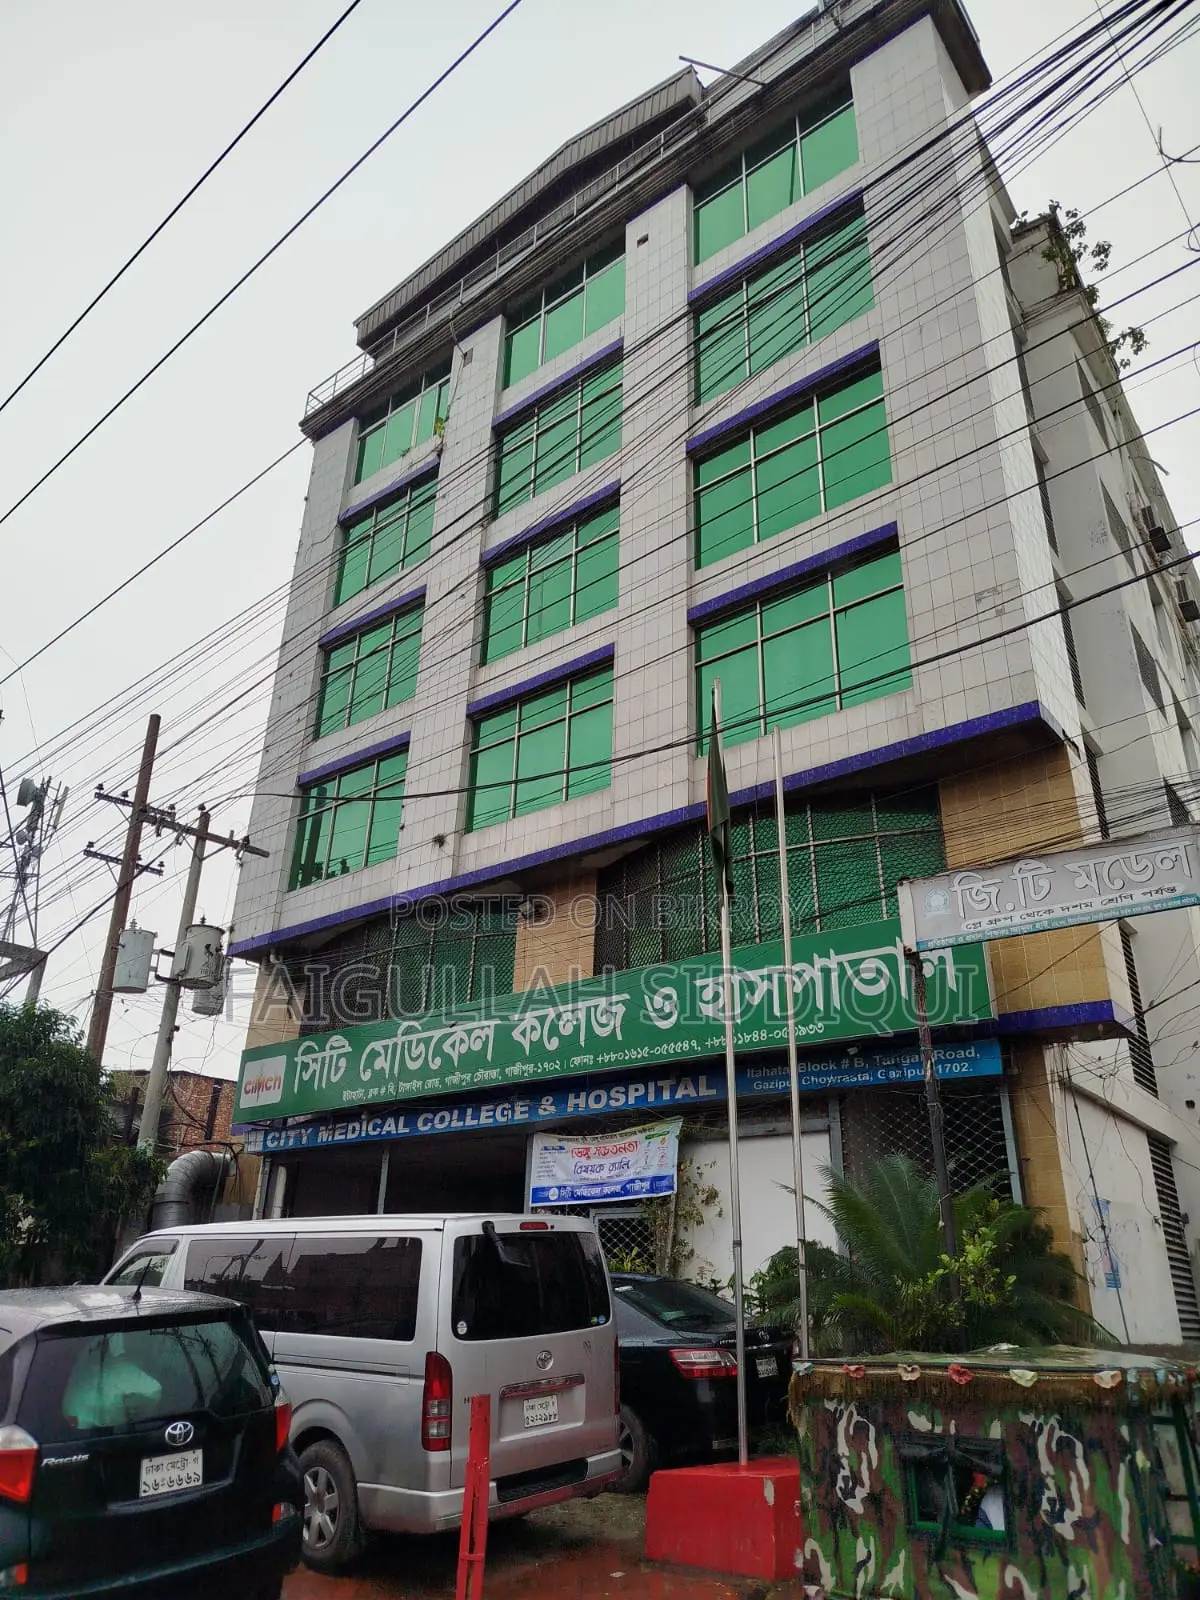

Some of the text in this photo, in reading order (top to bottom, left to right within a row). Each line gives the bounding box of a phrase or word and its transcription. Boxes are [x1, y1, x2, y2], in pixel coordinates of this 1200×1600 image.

[949, 841, 1197, 919] জি.টি মডেল
[1019, 908, 1055, 920] থেকে
[1059, 901, 1093, 912] দশম
[294, 937, 957, 1095] সিটি মেডিকেল কলেজ ও হাসপাতাল
[444, 1070, 471, 1087] গাজীপুর
[504, 1059, 562, 1079] গাজীপুর-১৭০২
[797, 1059, 837, 1073] Block
[840, 1058, 850, 1069] #
[854, 1056, 869, 1069] B,
[934, 1045, 980, 1060] Road,
[753, 1078, 793, 1092] Gazipu
[877, 1066, 926, 1080] Gazipu
[937, 1062, 973, 1073] 1702.
[266, 1075, 717, 1148] CITY MEDICAL COLLEGE & HOSPITAL
[573, 1160, 606, 1175] বিষয়ক
[41, 1453, 90, 1468] Ractis
[145, 1463, 164, 1476] ঢাকা
